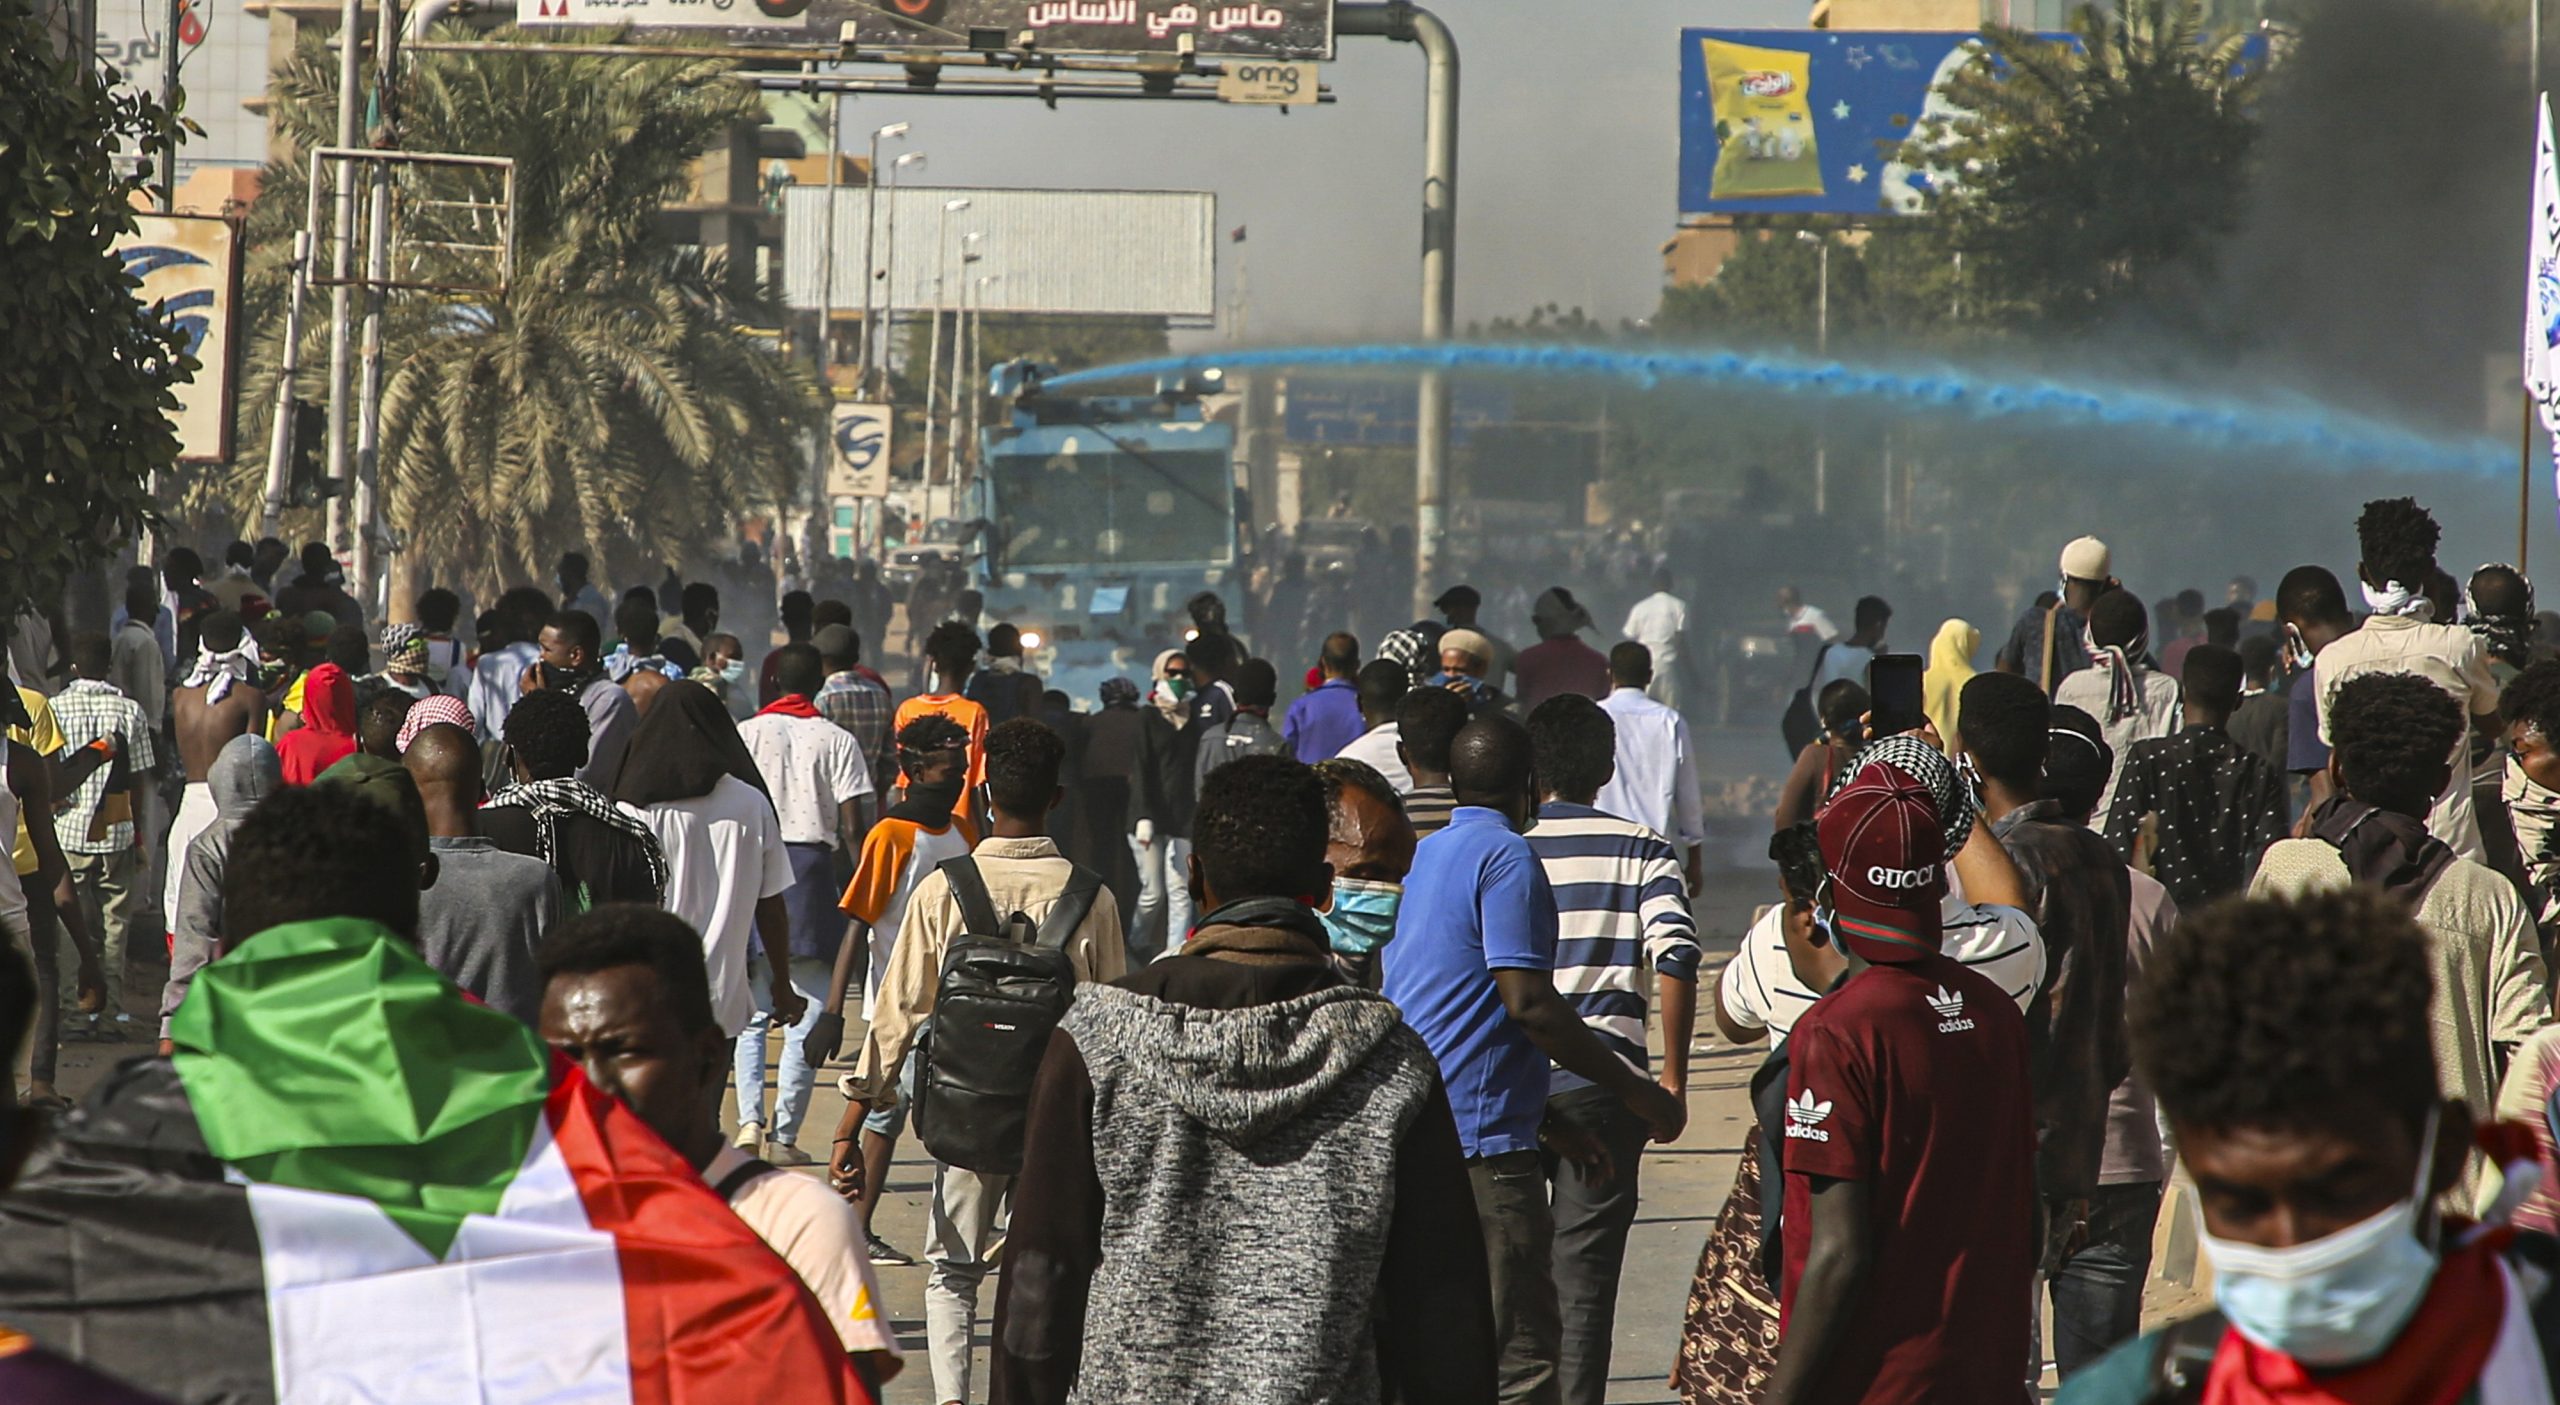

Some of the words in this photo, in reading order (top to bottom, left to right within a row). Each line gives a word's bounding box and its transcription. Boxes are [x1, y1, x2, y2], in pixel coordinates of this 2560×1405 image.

[1146, 2, 1199, 38] هي
[1208, 3, 1284, 33] ماس
[1239, 66, 1299, 94] omg
[1867, 864, 1935, 888] GUCCI
[1938, 1017, 1975, 1033] adidas
